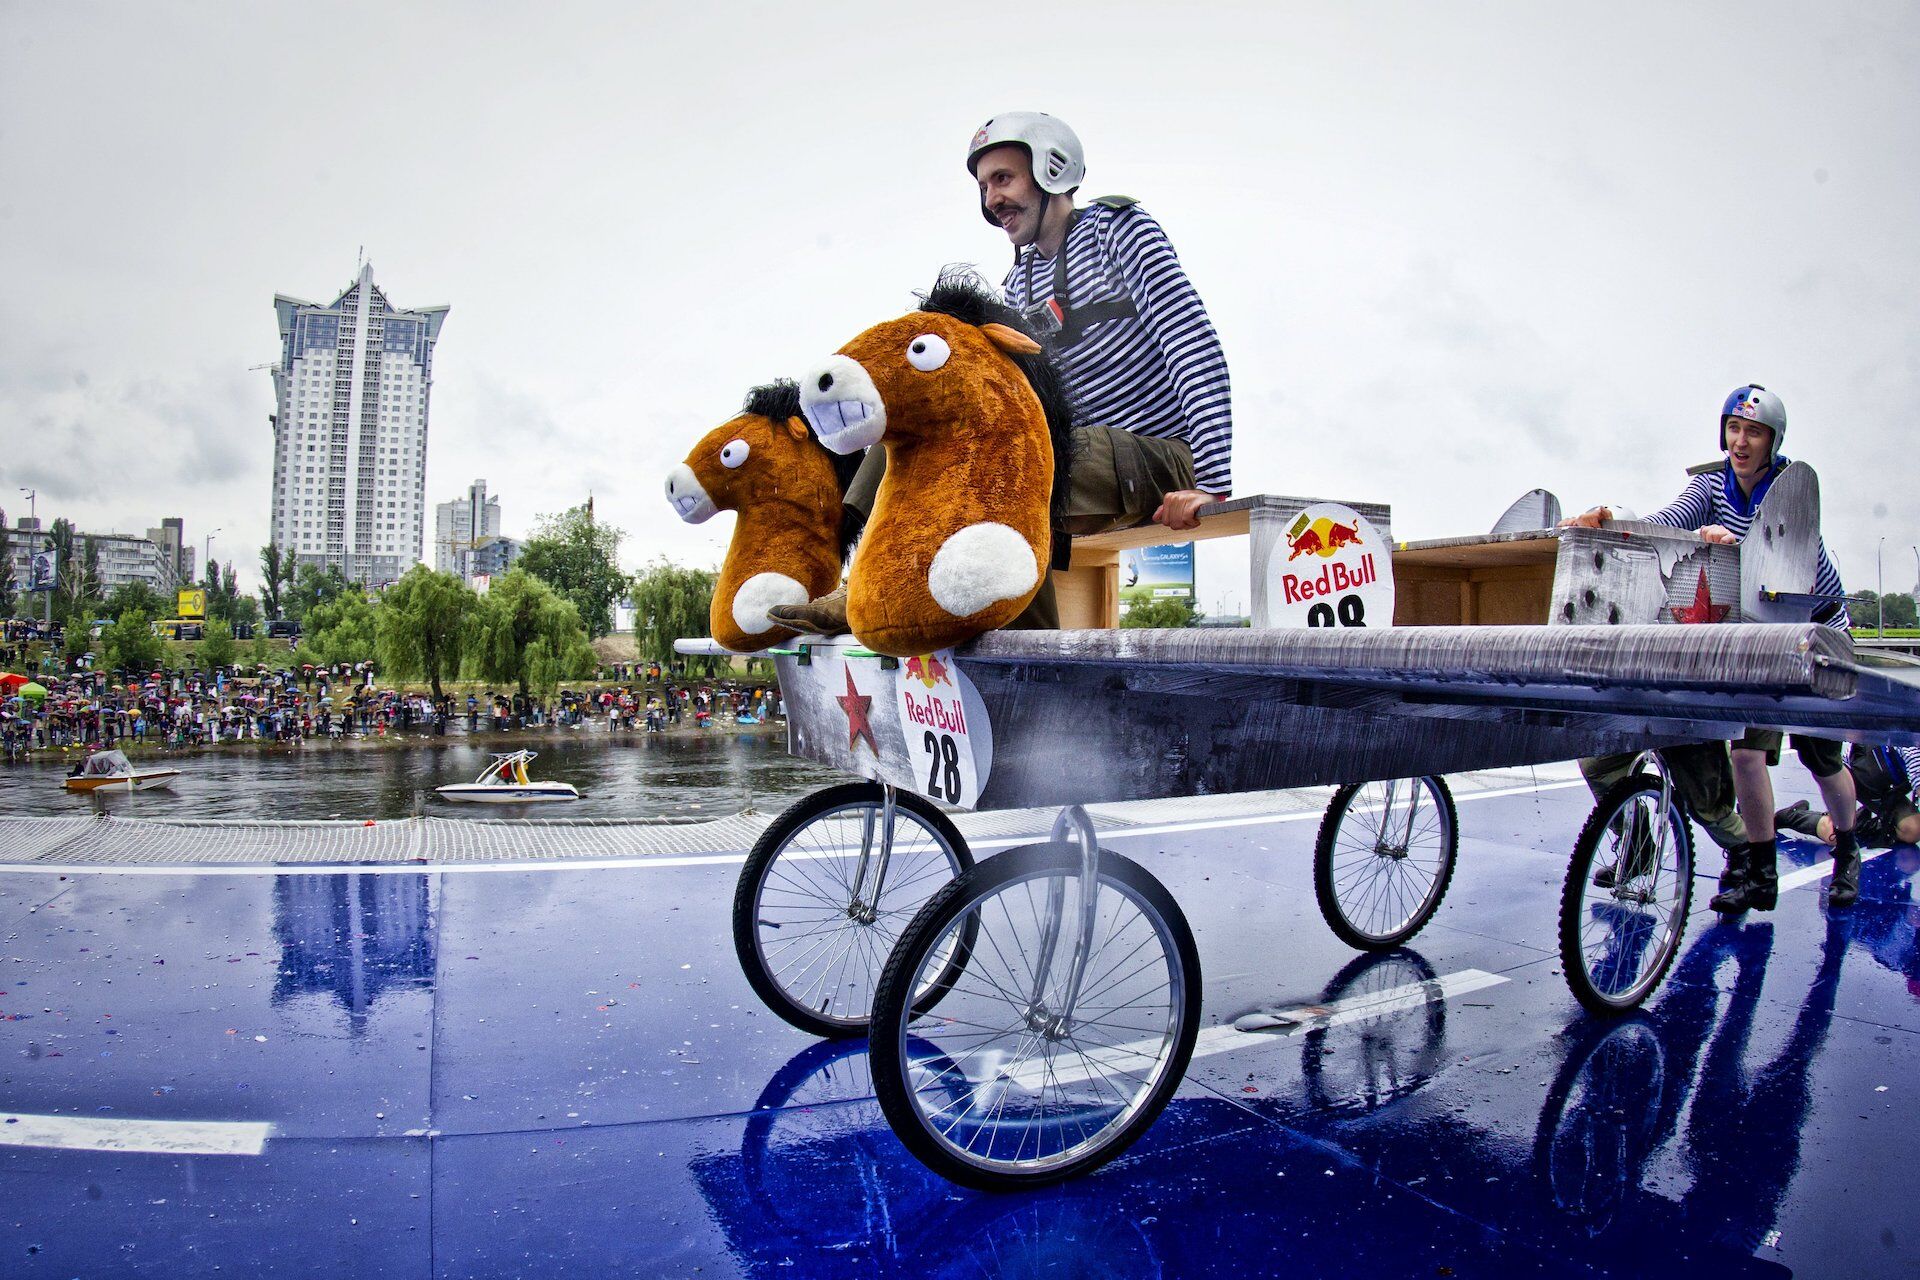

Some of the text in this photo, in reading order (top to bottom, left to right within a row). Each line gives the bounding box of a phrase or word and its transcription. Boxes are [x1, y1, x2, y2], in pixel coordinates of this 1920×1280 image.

[1282, 553, 1376, 605] Red Bull
[904, 691, 967, 735] Red Bull
[924, 730, 962, 805] 28
